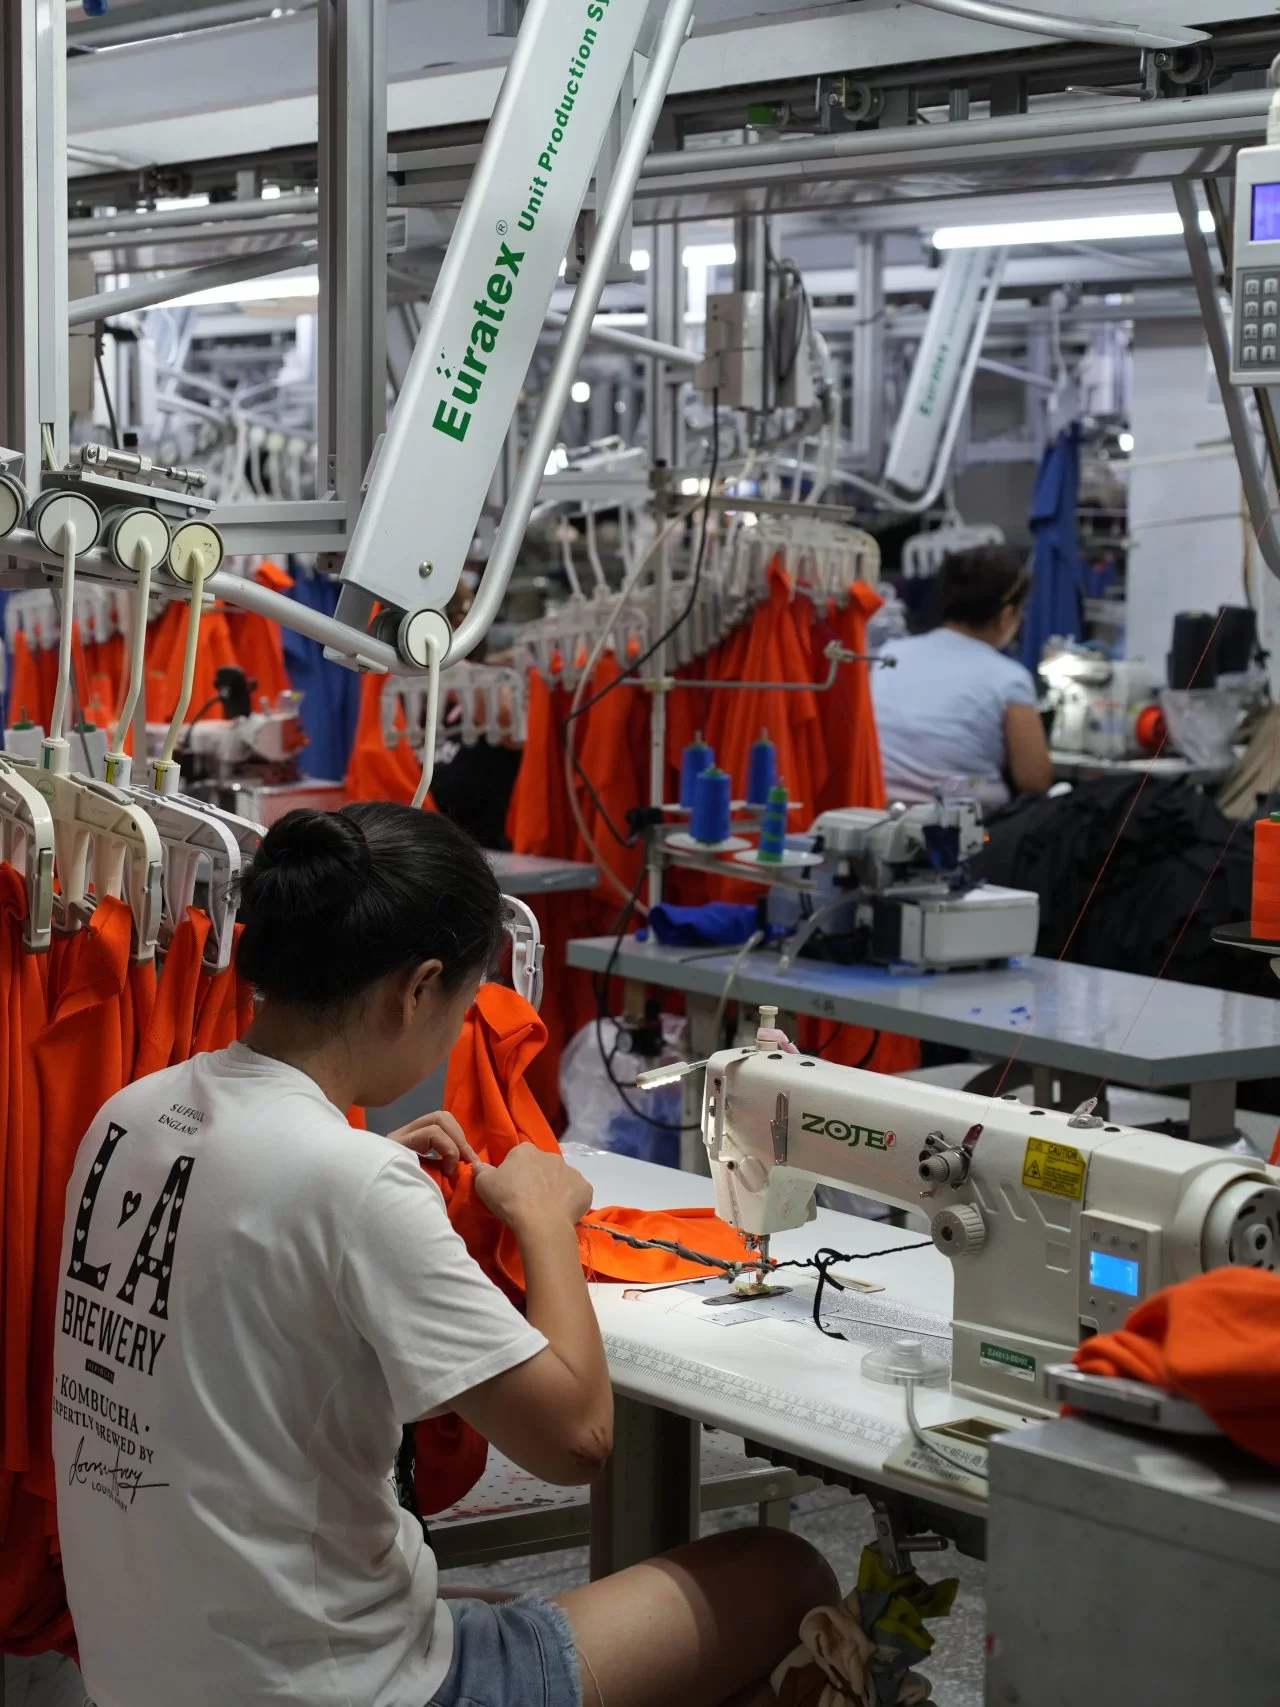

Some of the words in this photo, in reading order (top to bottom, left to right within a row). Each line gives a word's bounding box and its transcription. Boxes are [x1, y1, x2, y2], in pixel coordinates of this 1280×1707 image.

[518, 176, 547, 232] Unit
[537, 28, 597, 172] Production
[158, 1114, 198, 1135] ENGLAND
[801, 1112, 888, 1151] ZOJE
[1048, 1144, 1077, 1161] CAUTION
[62, 1289, 166, 1376] BREWERY
[61, 1374, 139, 1435] KOMBUCHA
[139, 1445, 154, 1464] BY
